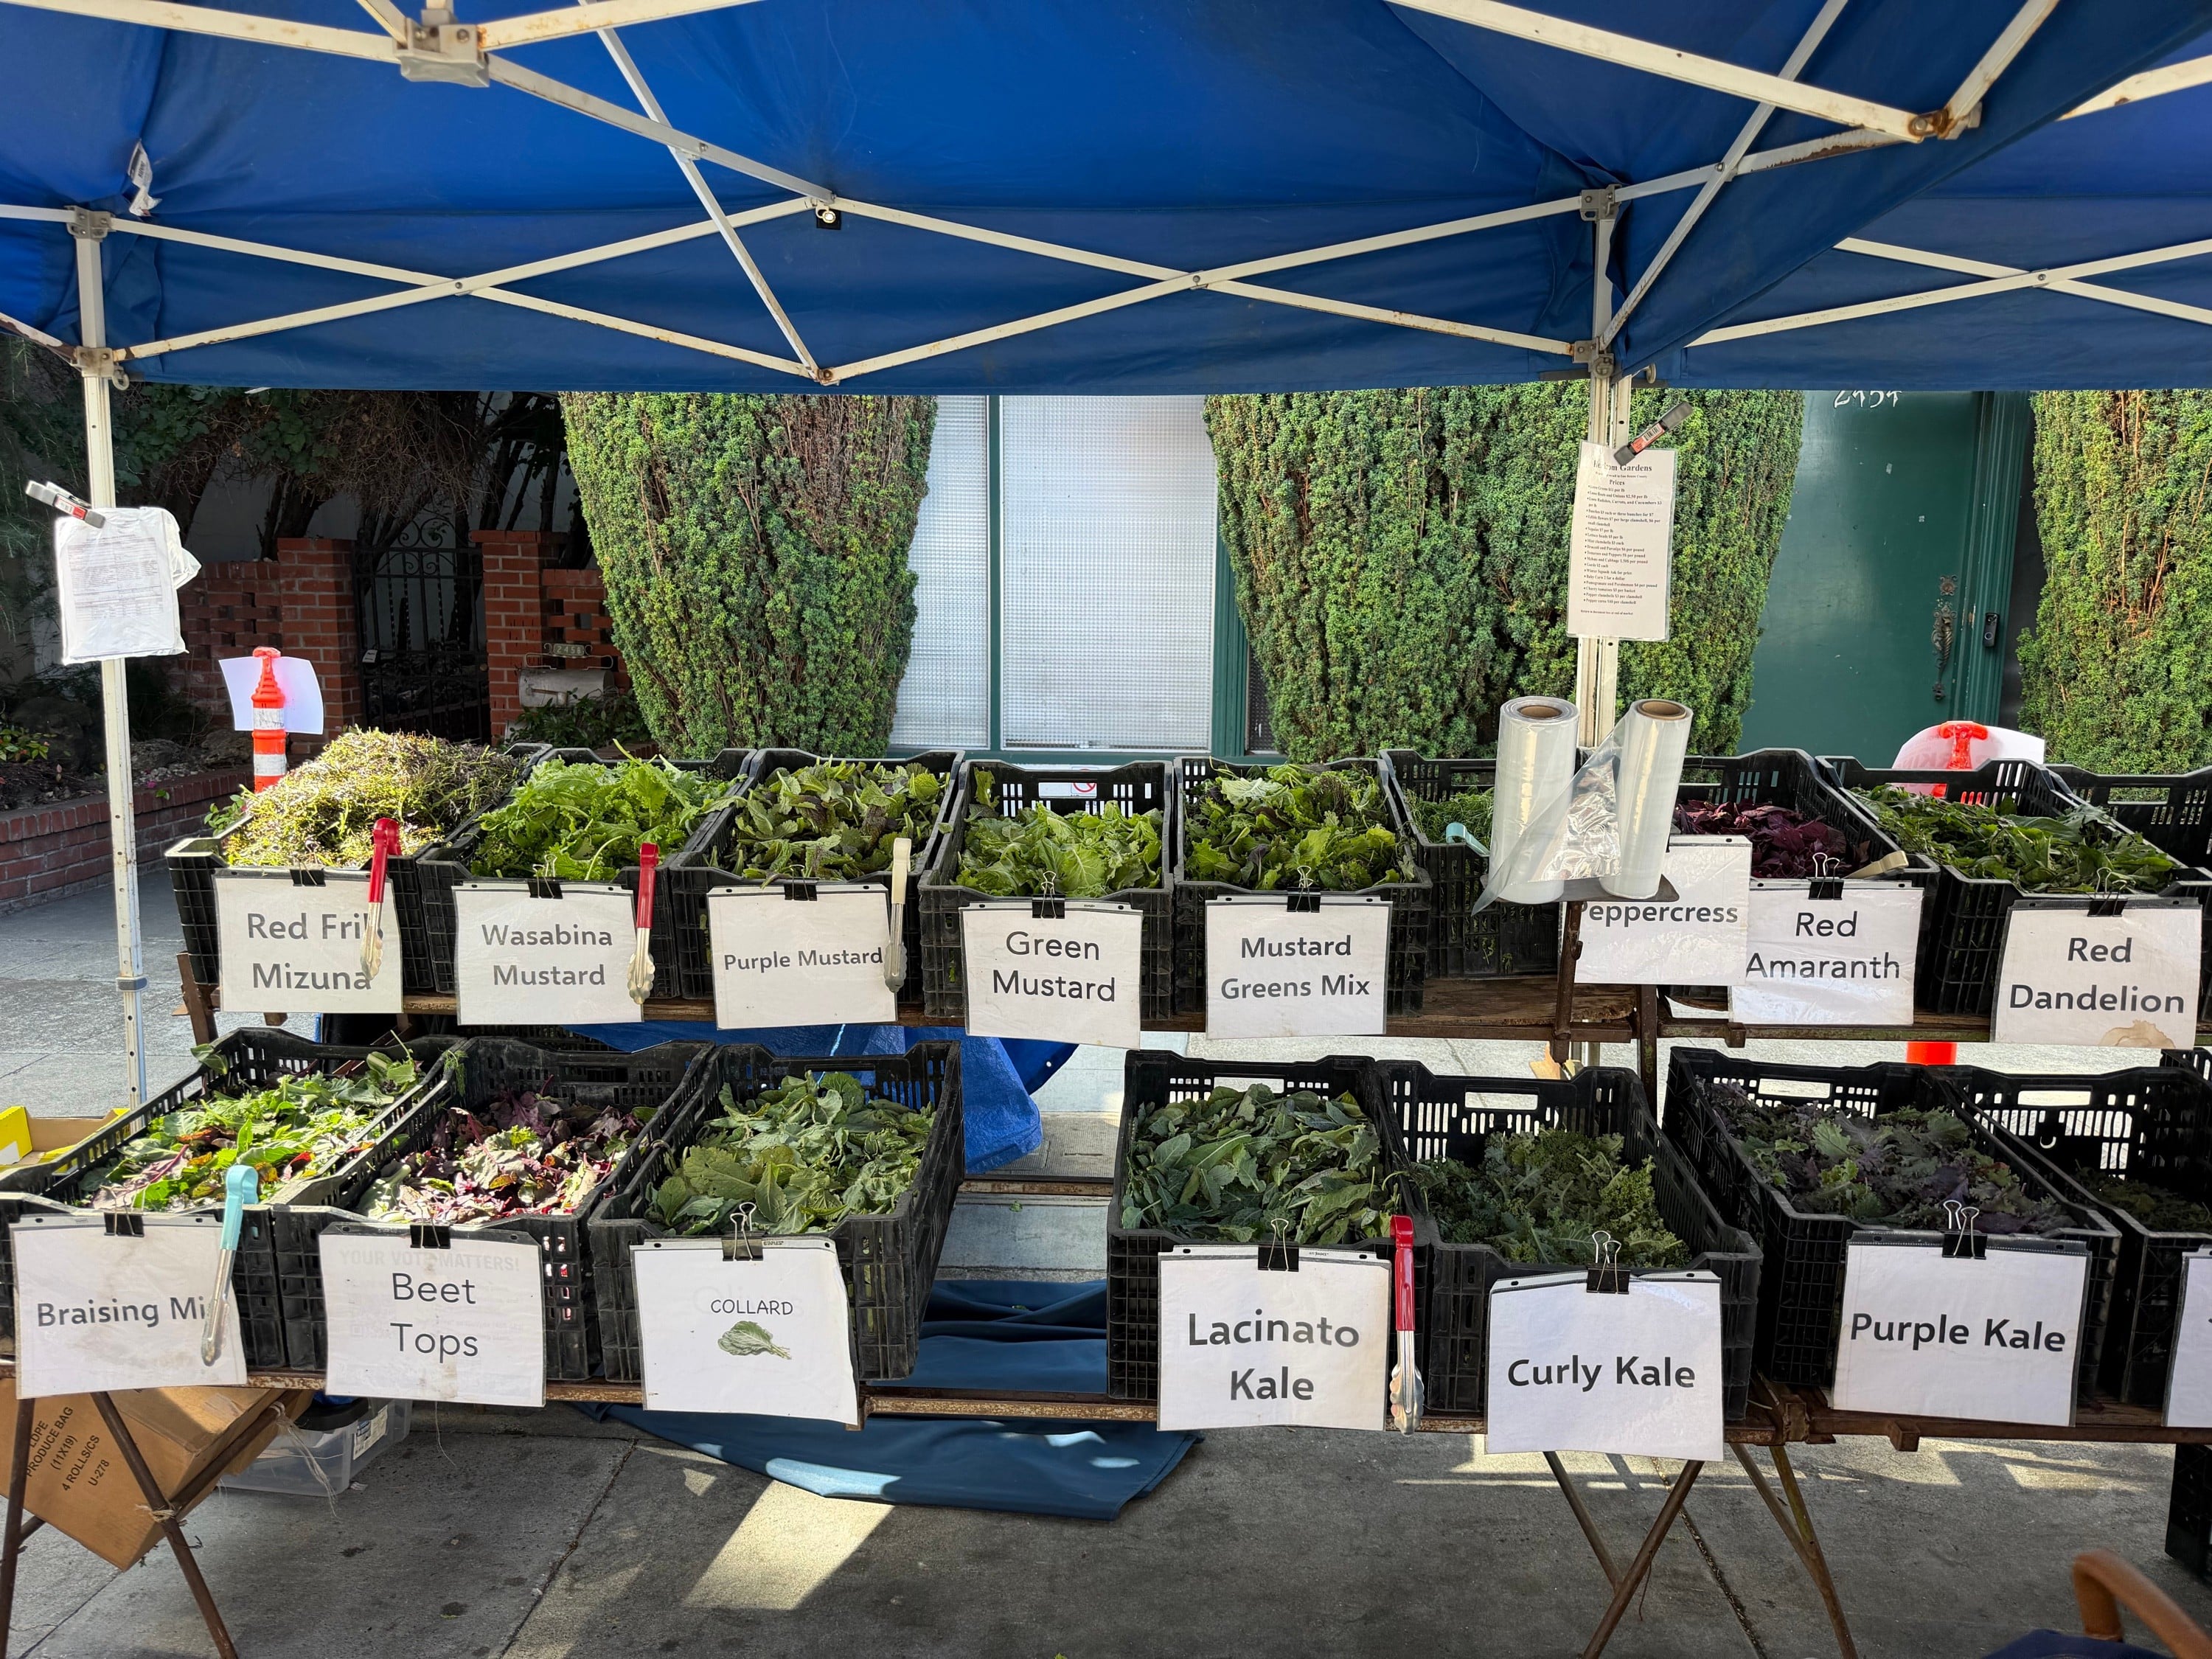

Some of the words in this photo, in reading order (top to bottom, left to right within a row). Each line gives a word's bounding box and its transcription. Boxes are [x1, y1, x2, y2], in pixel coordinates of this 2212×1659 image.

[248, 913, 308, 940] Red
[481, 924, 613, 946] Wasabina
[1795, 911, 1858, 937] Red
[1006, 931, 1099, 961] Green
[1242, 935, 1351, 958] Mustard
[2067, 937, 2132, 963] Red
[724, 951, 790, 973] Purple
[799, 947, 883, 967] Mustard
[1746, 952, 1899, 979] Amaranth
[253, 963, 372, 990] Mizuna
[493, 964, 605, 986] Mustard
[993, 970, 1115, 1002] Mustard
[1221, 978, 1311, 999] Greens
[1321, 974, 1370, 995] Mix
[2010, 984, 2184, 1014] Dandelion
[392, 1273, 476, 1304] Beet
[37, 1298, 159, 1328] Braising
[170, 1295, 206, 1320] Mi
[711, 1299, 793, 1315] COLLARD
[1189, 1309, 1359, 1347] Lacinato
[1851, 1312, 1969, 1351] Purple
[1985, 1318, 2065, 1352] Kale
[390, 1323, 478, 1363] Tops
[1231, 1366, 1314, 1400] Kale
[1508, 1354, 1602, 1392] Curly
[1616, 1356, 1694, 1388] Kale
[26, 1428, 60, 1477] PRODUCE
[55, 1407, 73, 1429] BAG
[29, 1420, 49, 1447] LDPE
[50, 1435, 78, 1470] (11X19)
[66, 1435, 100, 1484] ROLLS/CS
[88, 1459, 110, 1486] U-278
[62, 1483, 71, 1491] 4
